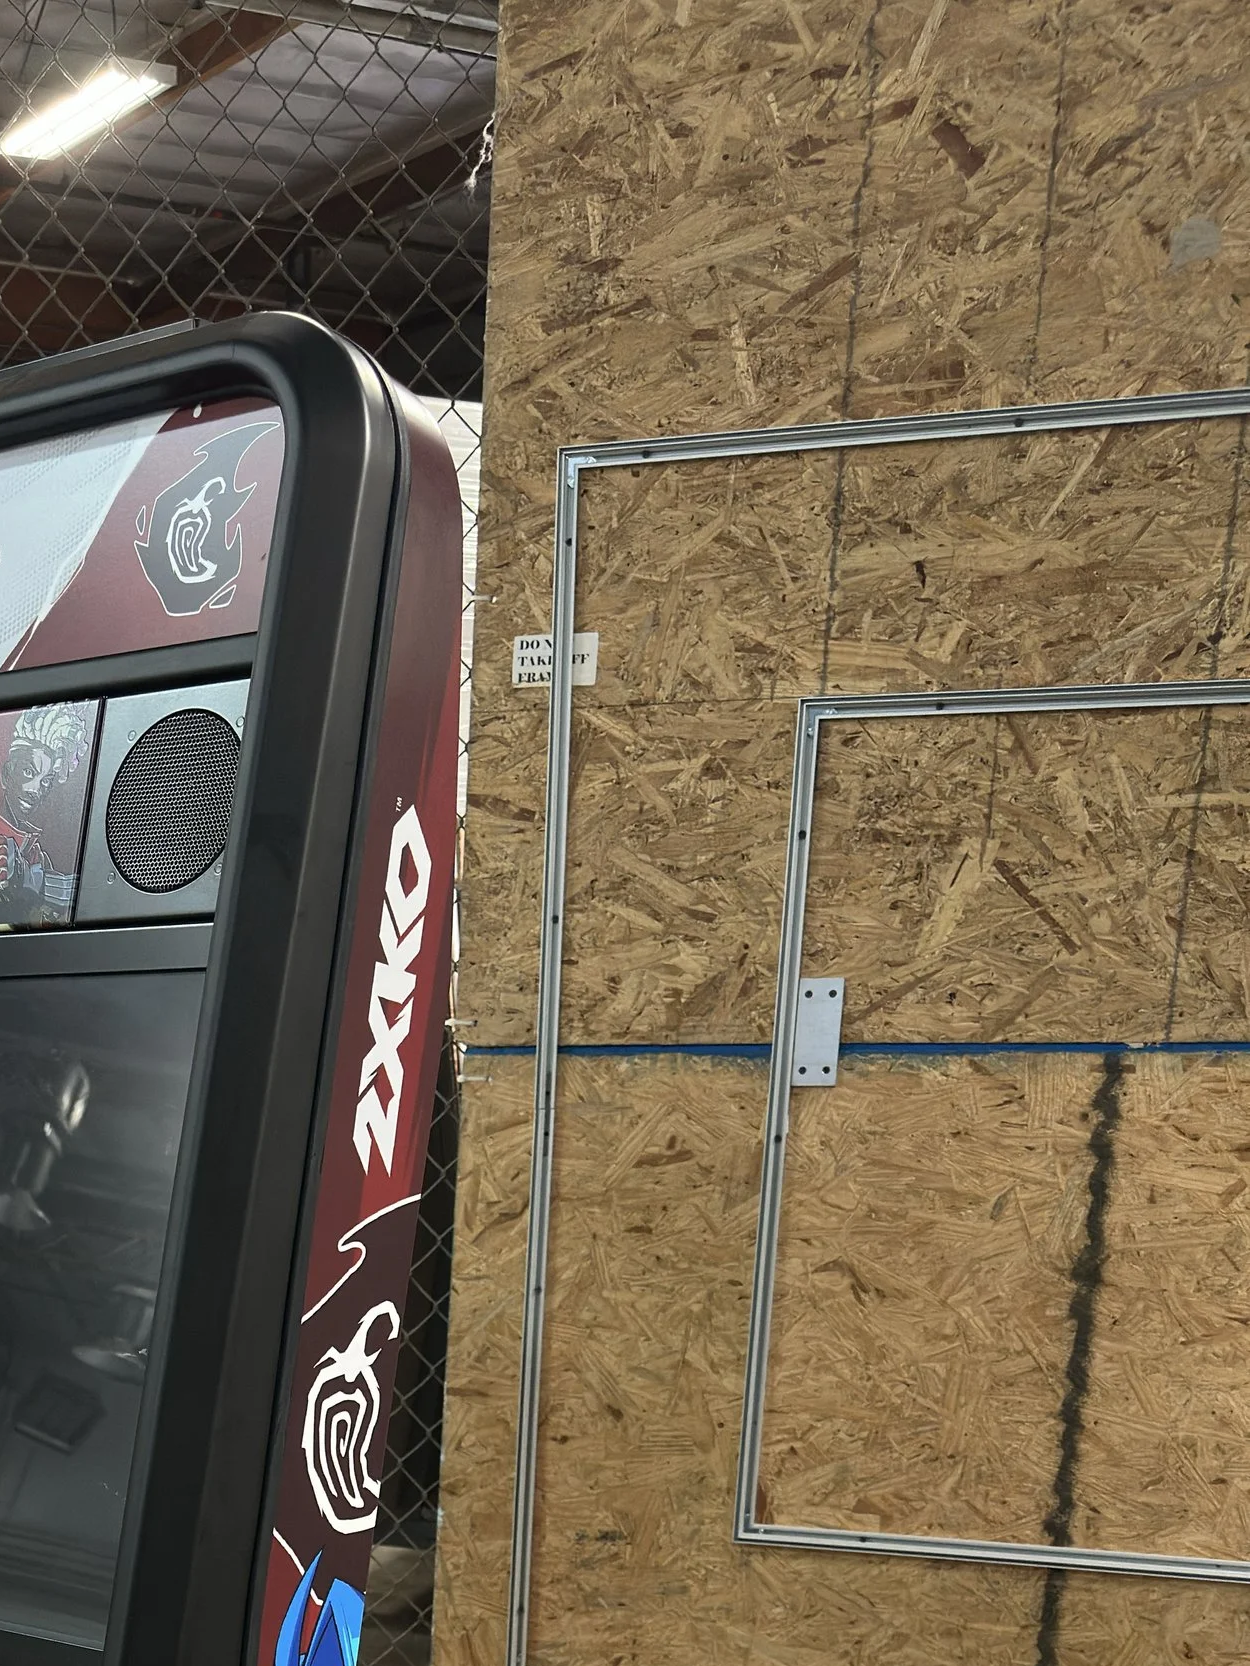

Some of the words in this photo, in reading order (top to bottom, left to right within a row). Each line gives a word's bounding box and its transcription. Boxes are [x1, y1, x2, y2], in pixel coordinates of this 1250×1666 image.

[519, 640, 540, 650] DO
[572, 653, 590, 664] FF
[352, 804, 432, 1178] 2XKO
